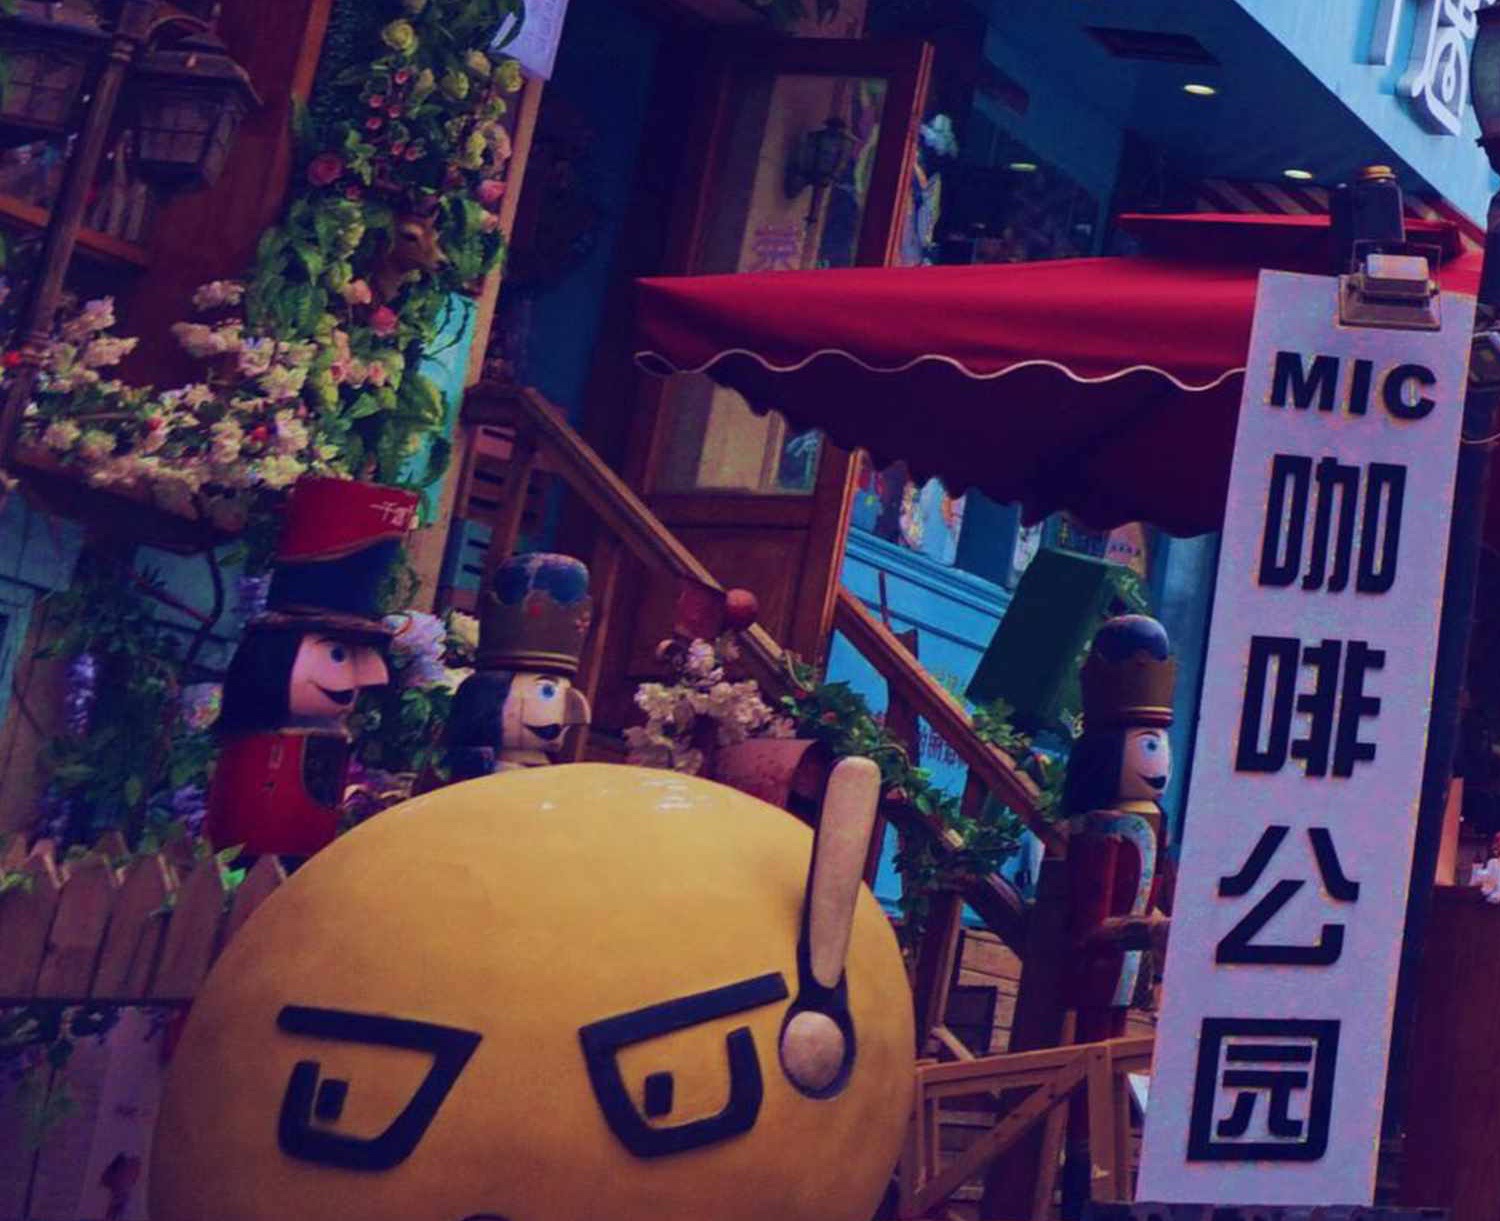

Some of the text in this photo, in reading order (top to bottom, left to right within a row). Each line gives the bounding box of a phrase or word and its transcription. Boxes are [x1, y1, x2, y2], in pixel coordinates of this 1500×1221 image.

[1270, 350, 1437, 422] MIC
[1185, 452, 1408, 1162] 咖啡公园
